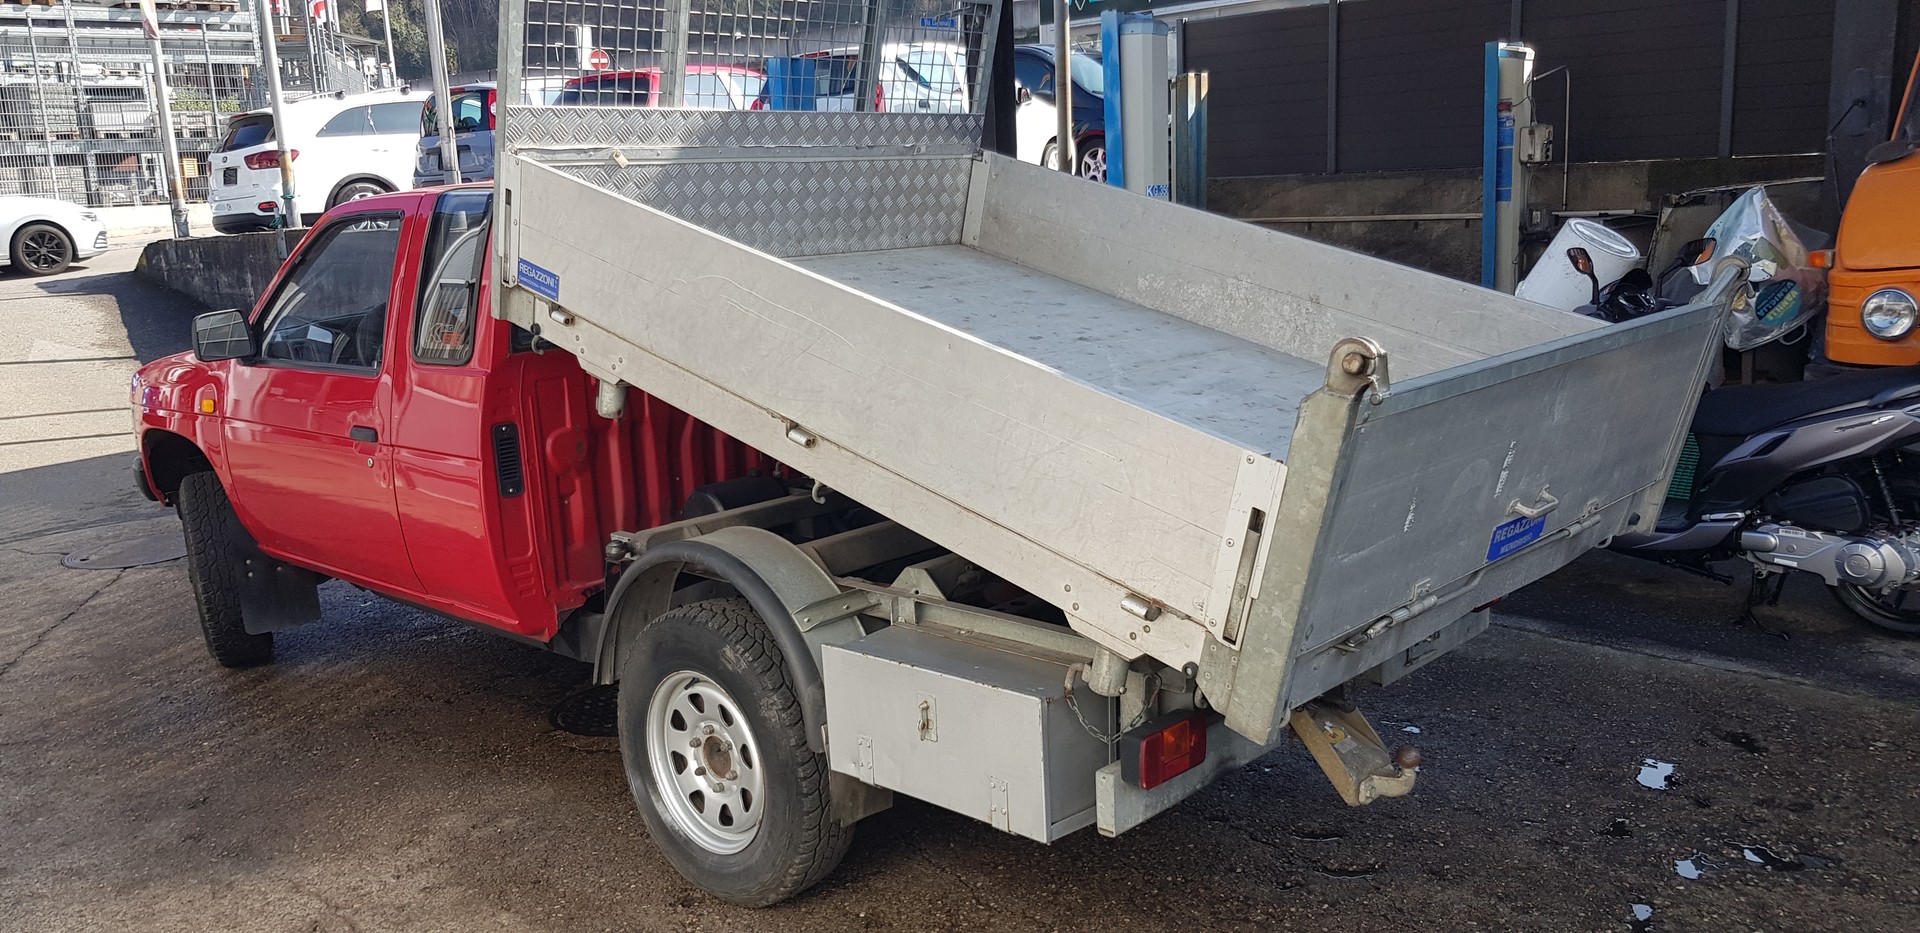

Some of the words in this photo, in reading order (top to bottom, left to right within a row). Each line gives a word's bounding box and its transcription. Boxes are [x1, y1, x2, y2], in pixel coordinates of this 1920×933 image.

[519, 262, 555, 288] REGAZZONI
[1756, 281, 1794, 316] VANIGLIA
[1766, 290, 1798, 320] VANILLE
